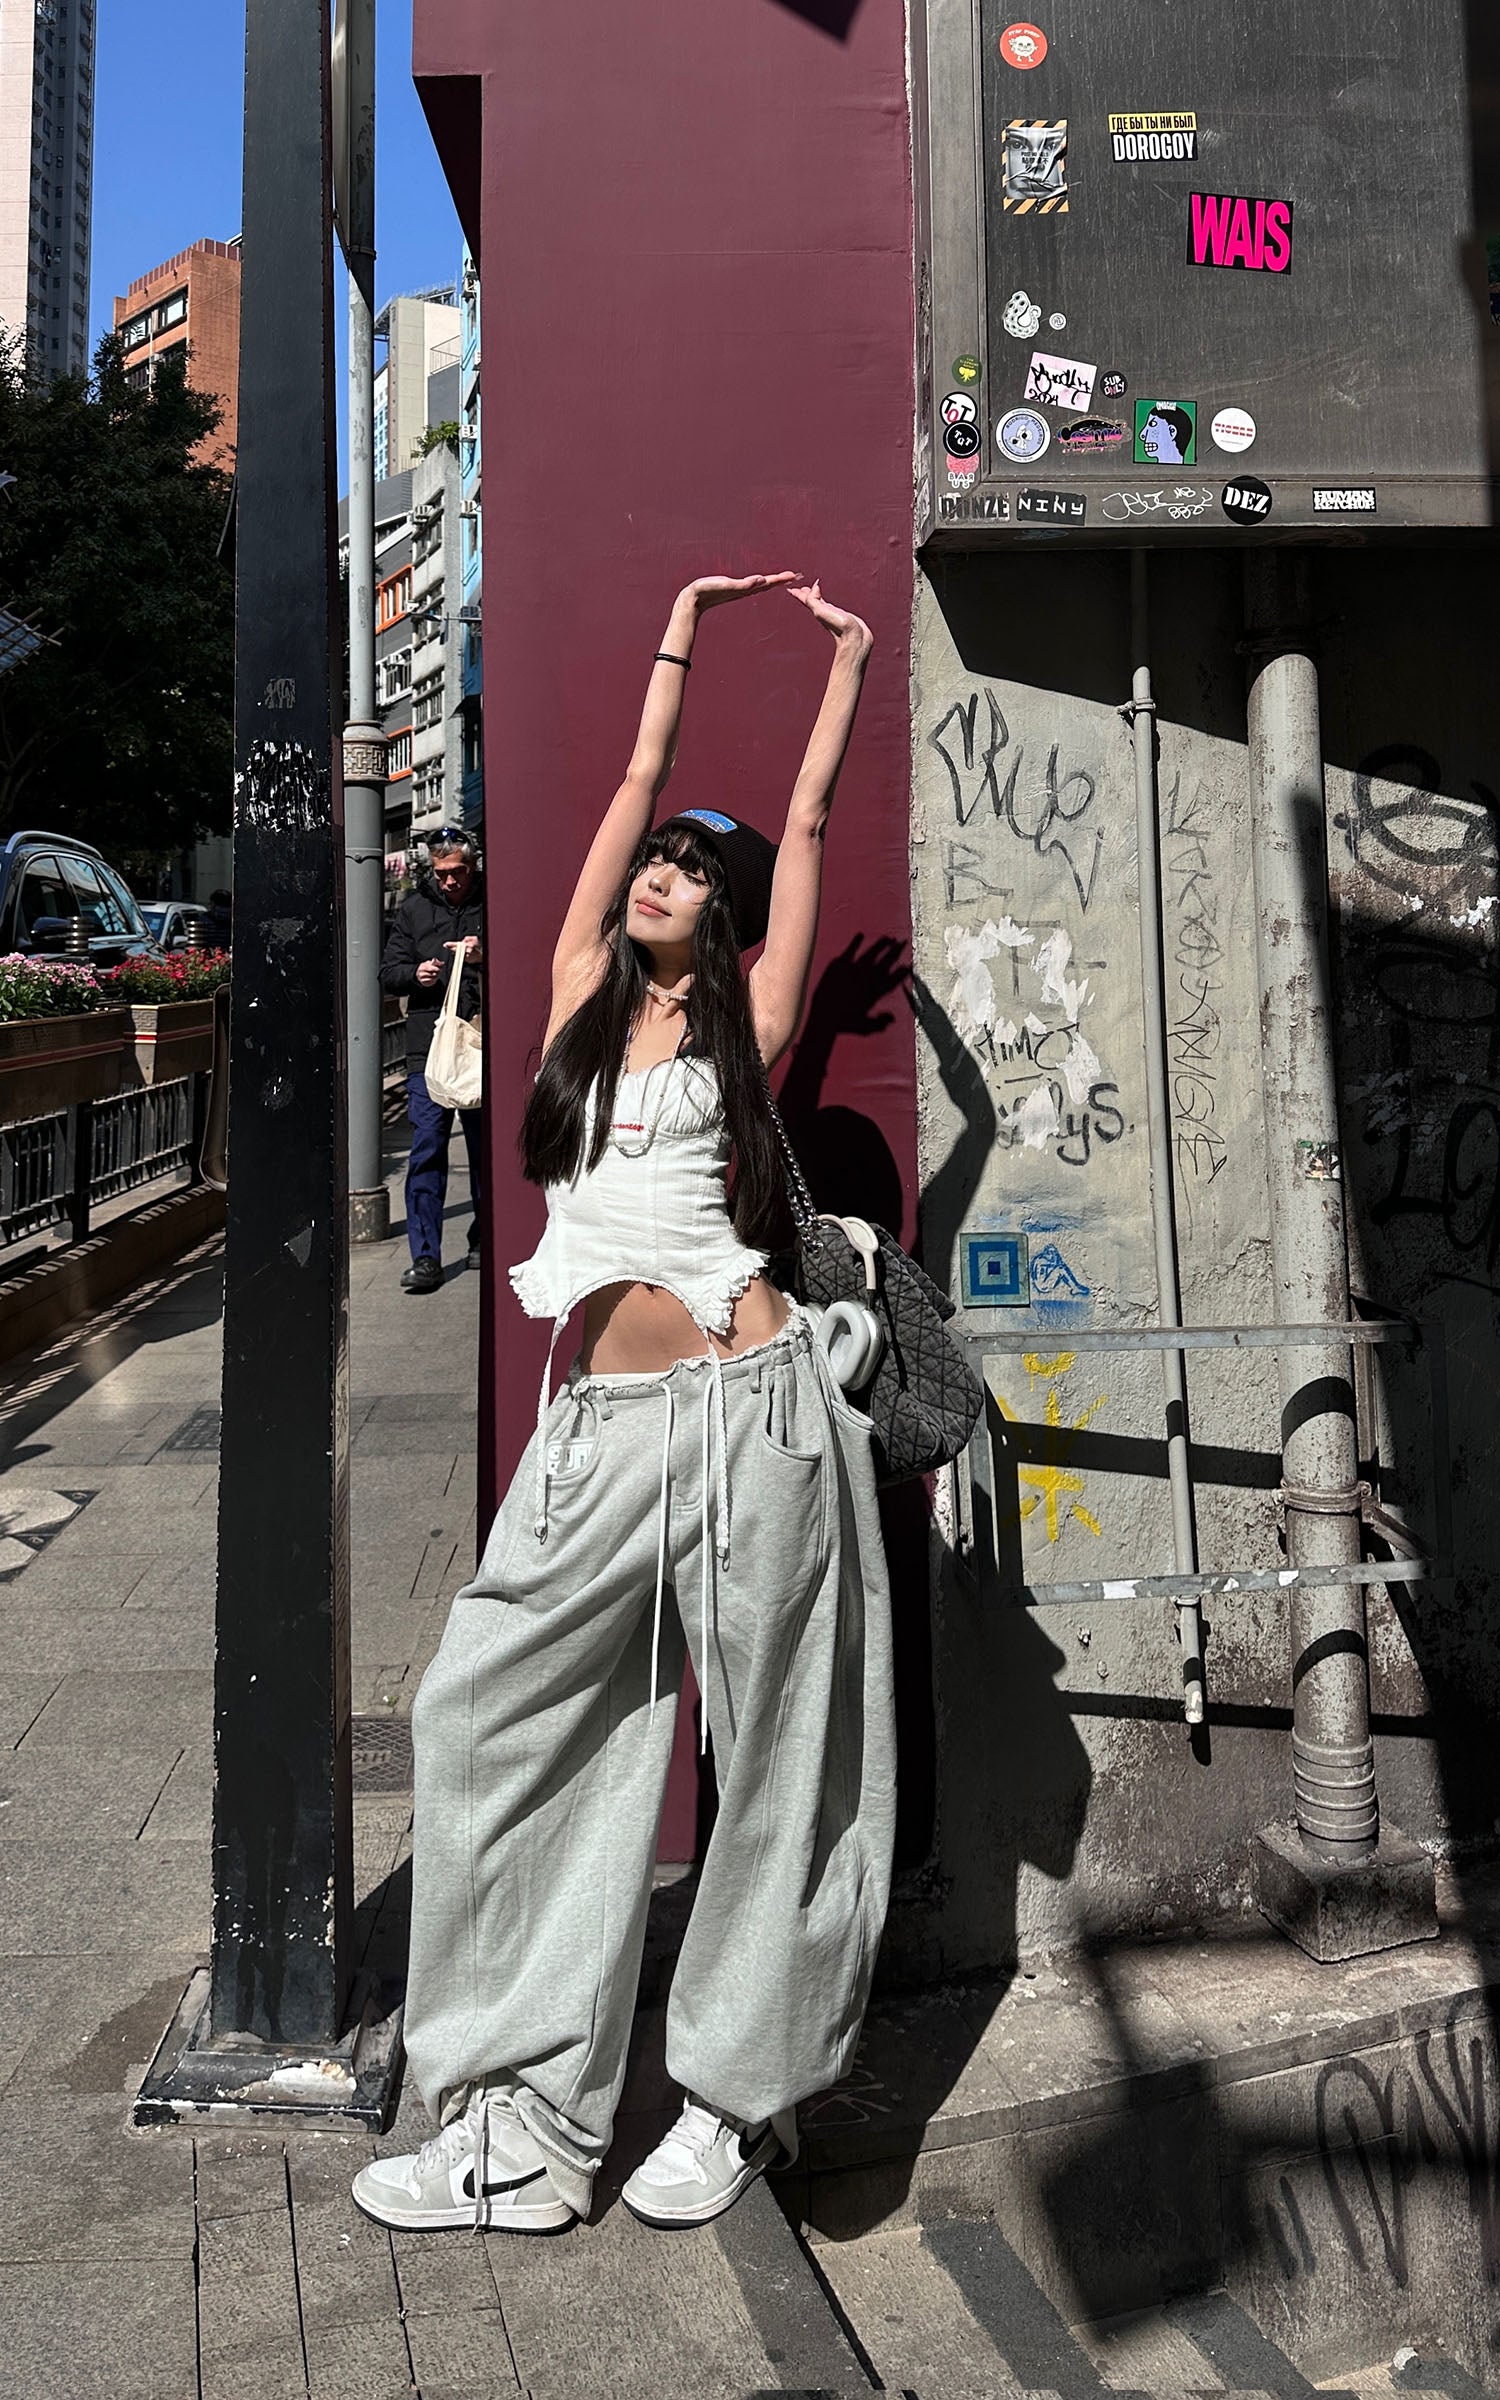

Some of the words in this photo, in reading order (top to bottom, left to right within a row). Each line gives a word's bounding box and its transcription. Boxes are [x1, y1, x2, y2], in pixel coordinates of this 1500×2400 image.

[1111, 117, 1128, 132] ГДЕ
[1129, 116, 1143, 129] БЫ
[1145, 116, 1158, 129] ТЫ
[1160, 115, 1172, 128] НИ
[1174, 115, 1193, 128] БЫЛ
[1113, 132, 1194, 160] DOROGOY
[1191, 194, 1290, 271] WAIS
[1104, 375, 1121, 386] SUB
[1104, 381, 1125, 395] ONLY
[1224, 486, 1270, 514] DEZ
[1313, 490, 1375, 501] HUMAN
